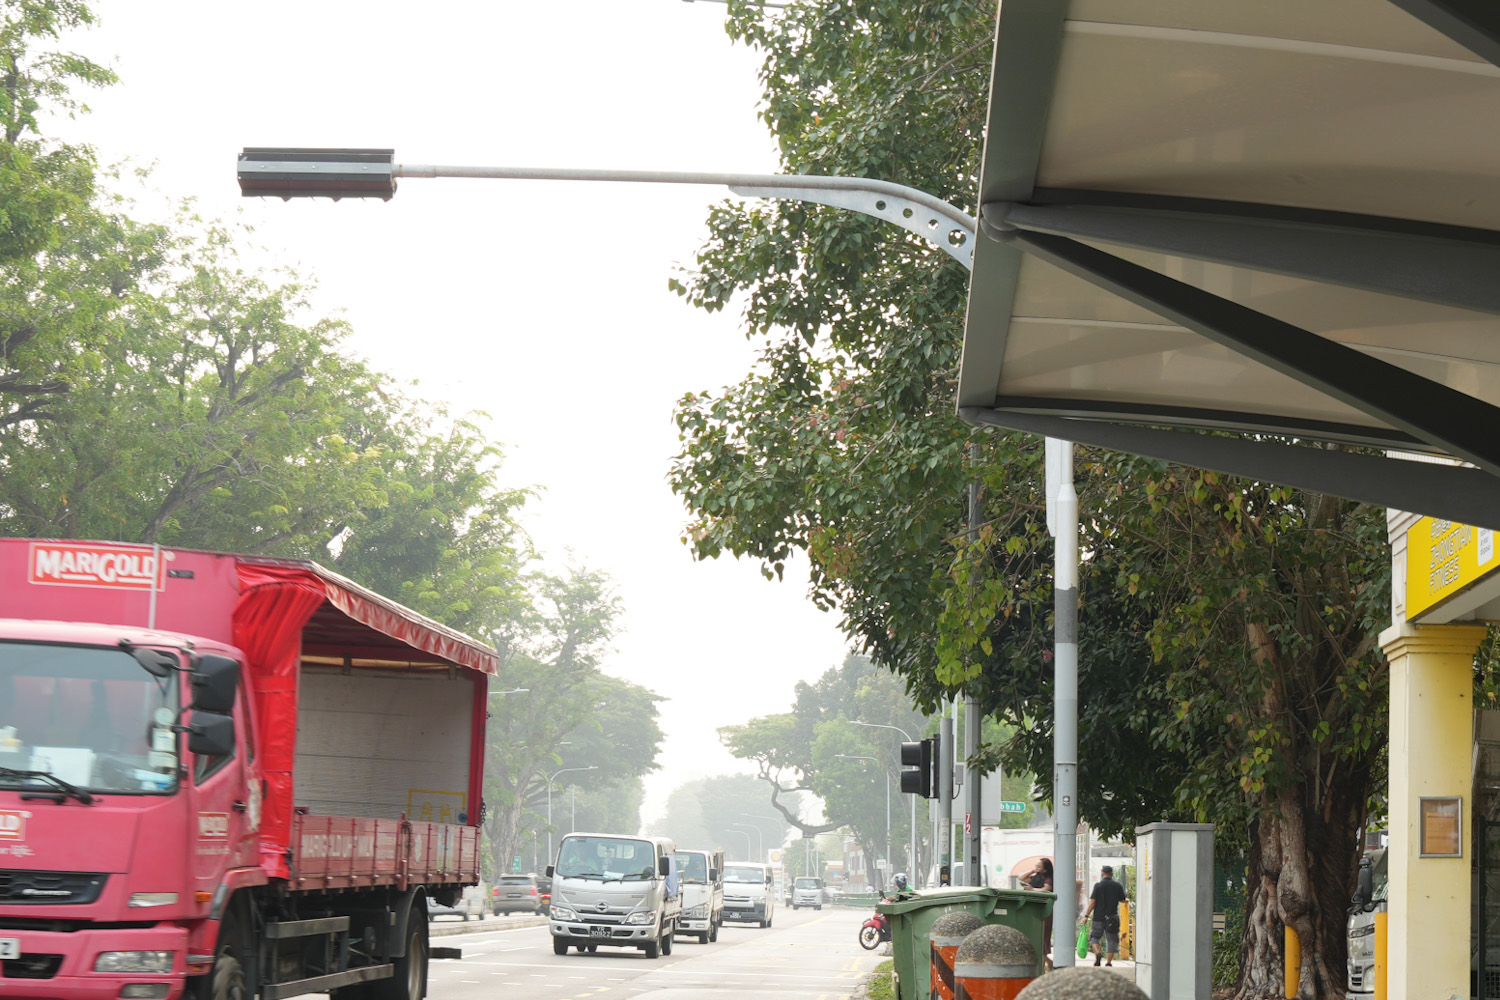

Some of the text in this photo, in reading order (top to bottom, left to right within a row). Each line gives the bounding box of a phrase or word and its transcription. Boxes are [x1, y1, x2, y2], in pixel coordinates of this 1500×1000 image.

[35, 548, 156, 583] MARIGOLD
[1430, 524, 1472, 569] ZHONGTIAN
[1429, 556, 1460, 596] FITNESS
